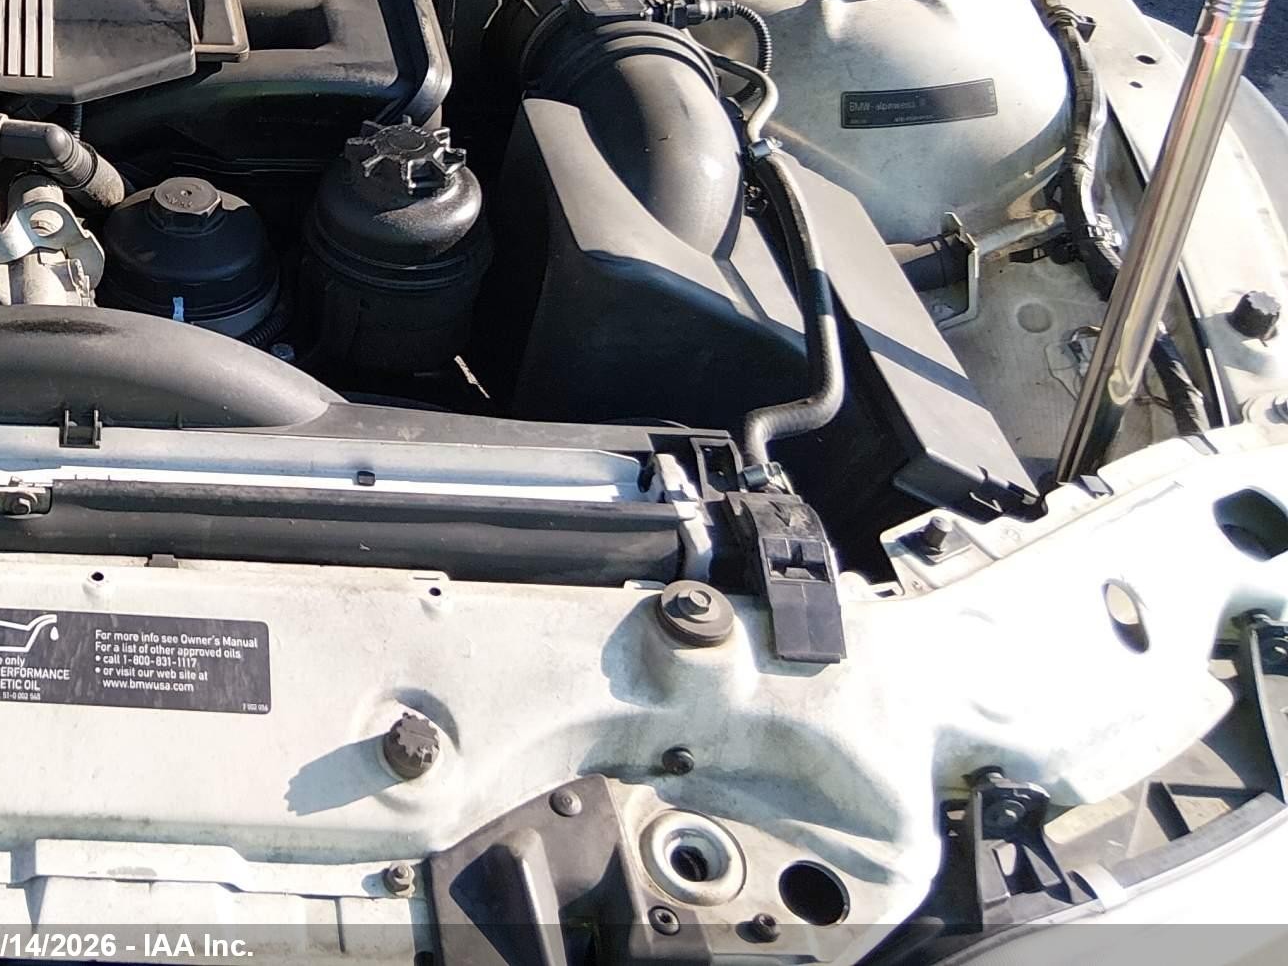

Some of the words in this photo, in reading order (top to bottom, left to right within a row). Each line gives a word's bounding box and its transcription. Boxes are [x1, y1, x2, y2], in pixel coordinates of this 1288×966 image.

[95, 630, 112, 641] For
[114, 632, 139, 642] more
[141, 633, 160, 643] info
[162, 635, 178, 643] see
[181, 634, 221, 646] Owner's
[223, 637, 258, 648] Manual
[95, 642, 112, 652] For
[113, 644, 120, 652] a
[122, 642, 137, 653] list
[138, 644, 149, 654] of
[150, 644, 175, 655] other
[177, 647, 221, 658] approved
[224, 649, 241, 659] oils
[5, 655, 26, 667] only
[103, 654, 121, 664] call
[123, 655, 197, 668] 1-800-831-1117
[103, 667, 114, 676] or
[116, 667, 135, 677] visit
[138, 669, 154, 678] our
[157, 669, 176, 679] web
[179, 671, 197, 680] site
[199, 672, 208, 681] at
[24, 680, 40, 690] OIL
[103, 678, 194, 692] www.bmwusa.com
